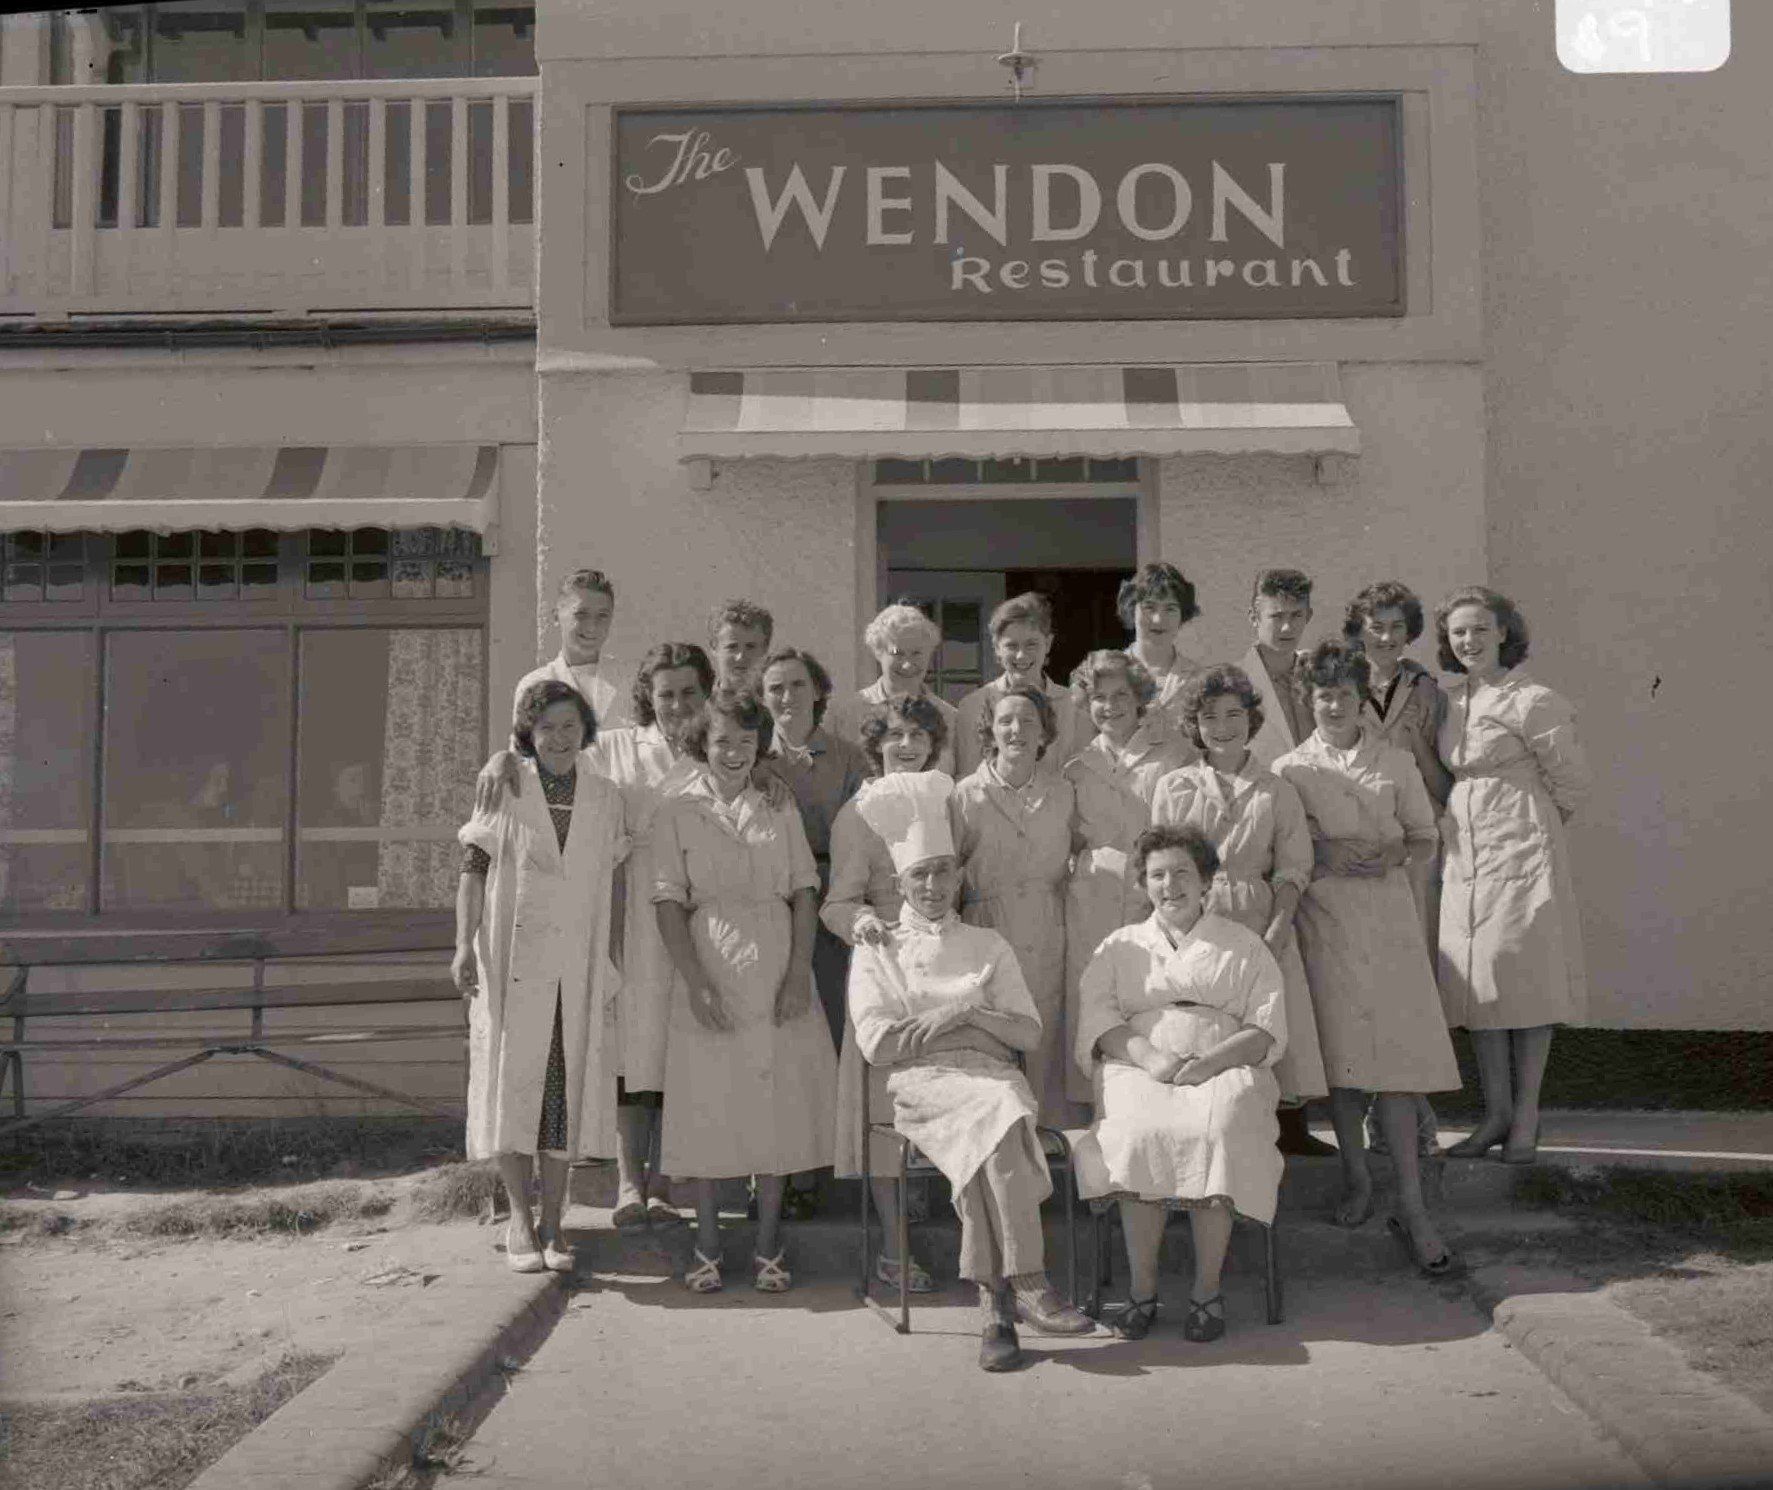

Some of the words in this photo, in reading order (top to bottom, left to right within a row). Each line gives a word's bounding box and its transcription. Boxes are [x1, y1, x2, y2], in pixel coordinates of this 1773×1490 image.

[627, 129, 738, 195] The
[745, 160, 1286, 251] WENDON
[950, 248, 1355, 293] Restaurant
